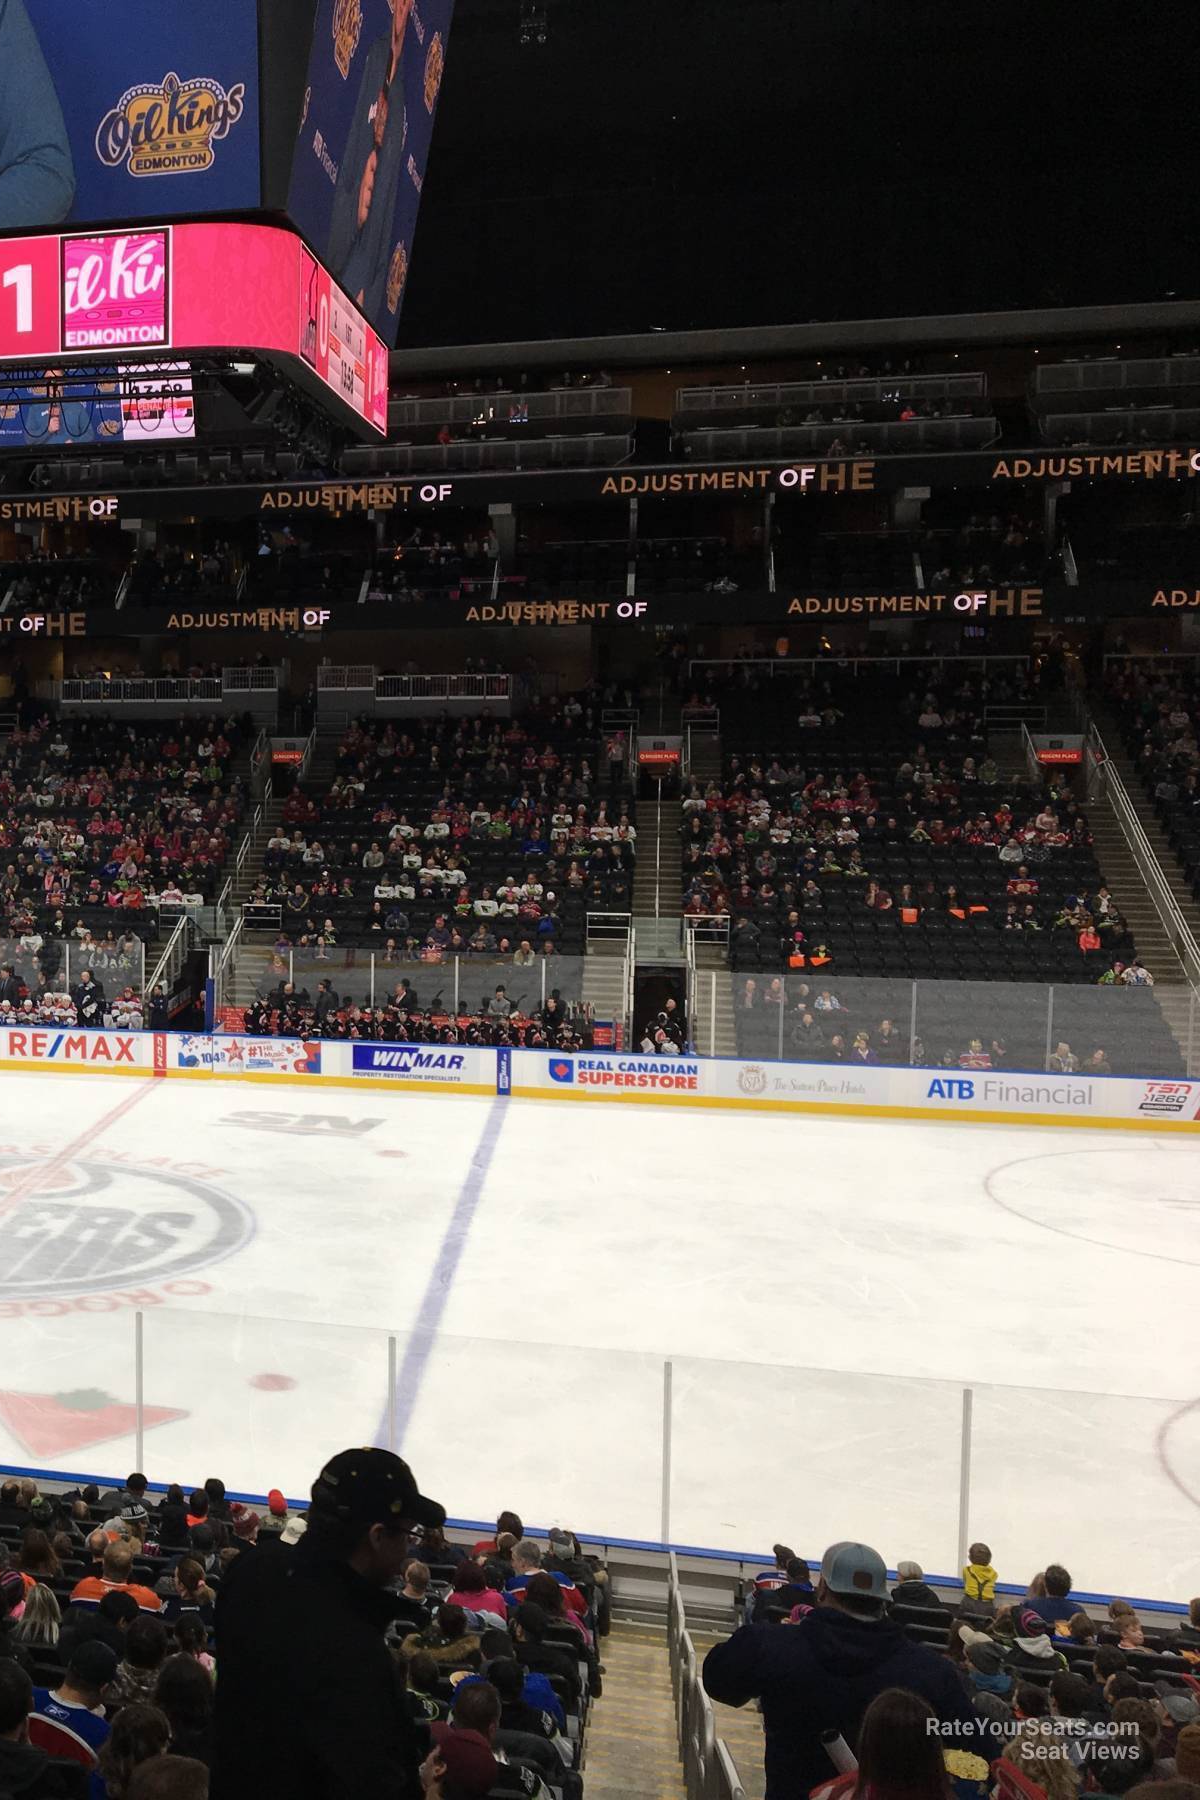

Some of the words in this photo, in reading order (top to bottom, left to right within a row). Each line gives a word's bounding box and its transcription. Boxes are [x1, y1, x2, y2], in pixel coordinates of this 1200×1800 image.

[96, 103, 162, 166] Oil
[164, 83, 245, 139] Kings
[135, 152, 208, 170] EDMONTON
[3, 263, 33, 333] 1
[319, 293, 329, 358] 0
[65, 325, 165, 348] EDMONTON
[601, 470, 771, 494] ADJUSTMENT
[779, 468, 815, 488] OF
[260, 486, 412, 509] ADJUSTMENT
[419, 484, 452, 502] OF
[89, 499, 118, 516] OF
[466, 603, 610, 622] ADJUSTMENT
[616, 602, 648, 618] OF
[788, 595, 946, 615] ADJUSTMENT
[953, 593, 987, 611] OF
[19, 617, 45, 631] OF
[167, 611, 296, 628] ADJUSTMENT
[303, 610, 331, 626] OF
[8, 1032, 136, 1062] RE/MAX
[248, 1045, 263, 1057] #1
[372, 1050, 465, 1070] WINMAR
[578, 1060, 613, 1071] REAL
[618, 1062, 698, 1076] CANADIAN
[383, 1072, 423, 1080] RESTORATION
[424, 1074, 461, 1082] SPECIALISTS
[577, 1071, 698, 1090] SUPERSTORE
[927, 1078, 975, 1099] ATB
[984, 1080, 1093, 1105] Financial
[1146, 1082, 1193, 1095] TSN
[1150, 1094, 1188, 1104] 1260
